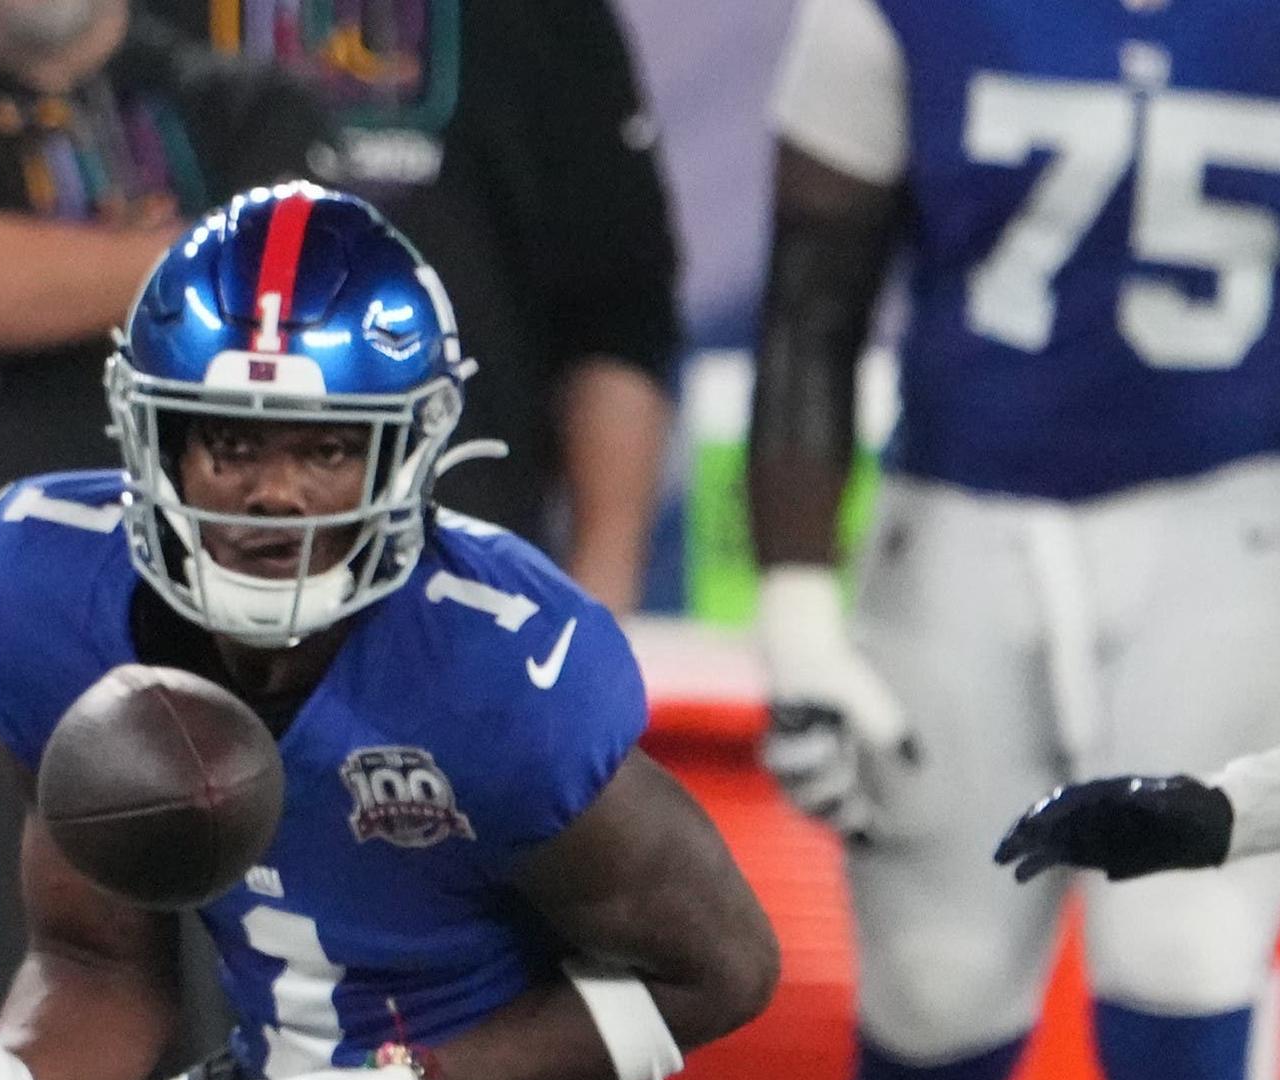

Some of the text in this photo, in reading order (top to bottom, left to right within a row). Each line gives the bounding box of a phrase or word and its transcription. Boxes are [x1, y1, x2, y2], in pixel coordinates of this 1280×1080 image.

[257, 292, 283, 351] 1
[3, 486, 123, 534] 1
[425, 568, 541, 633] 1
[349, 767, 451, 811] 100
